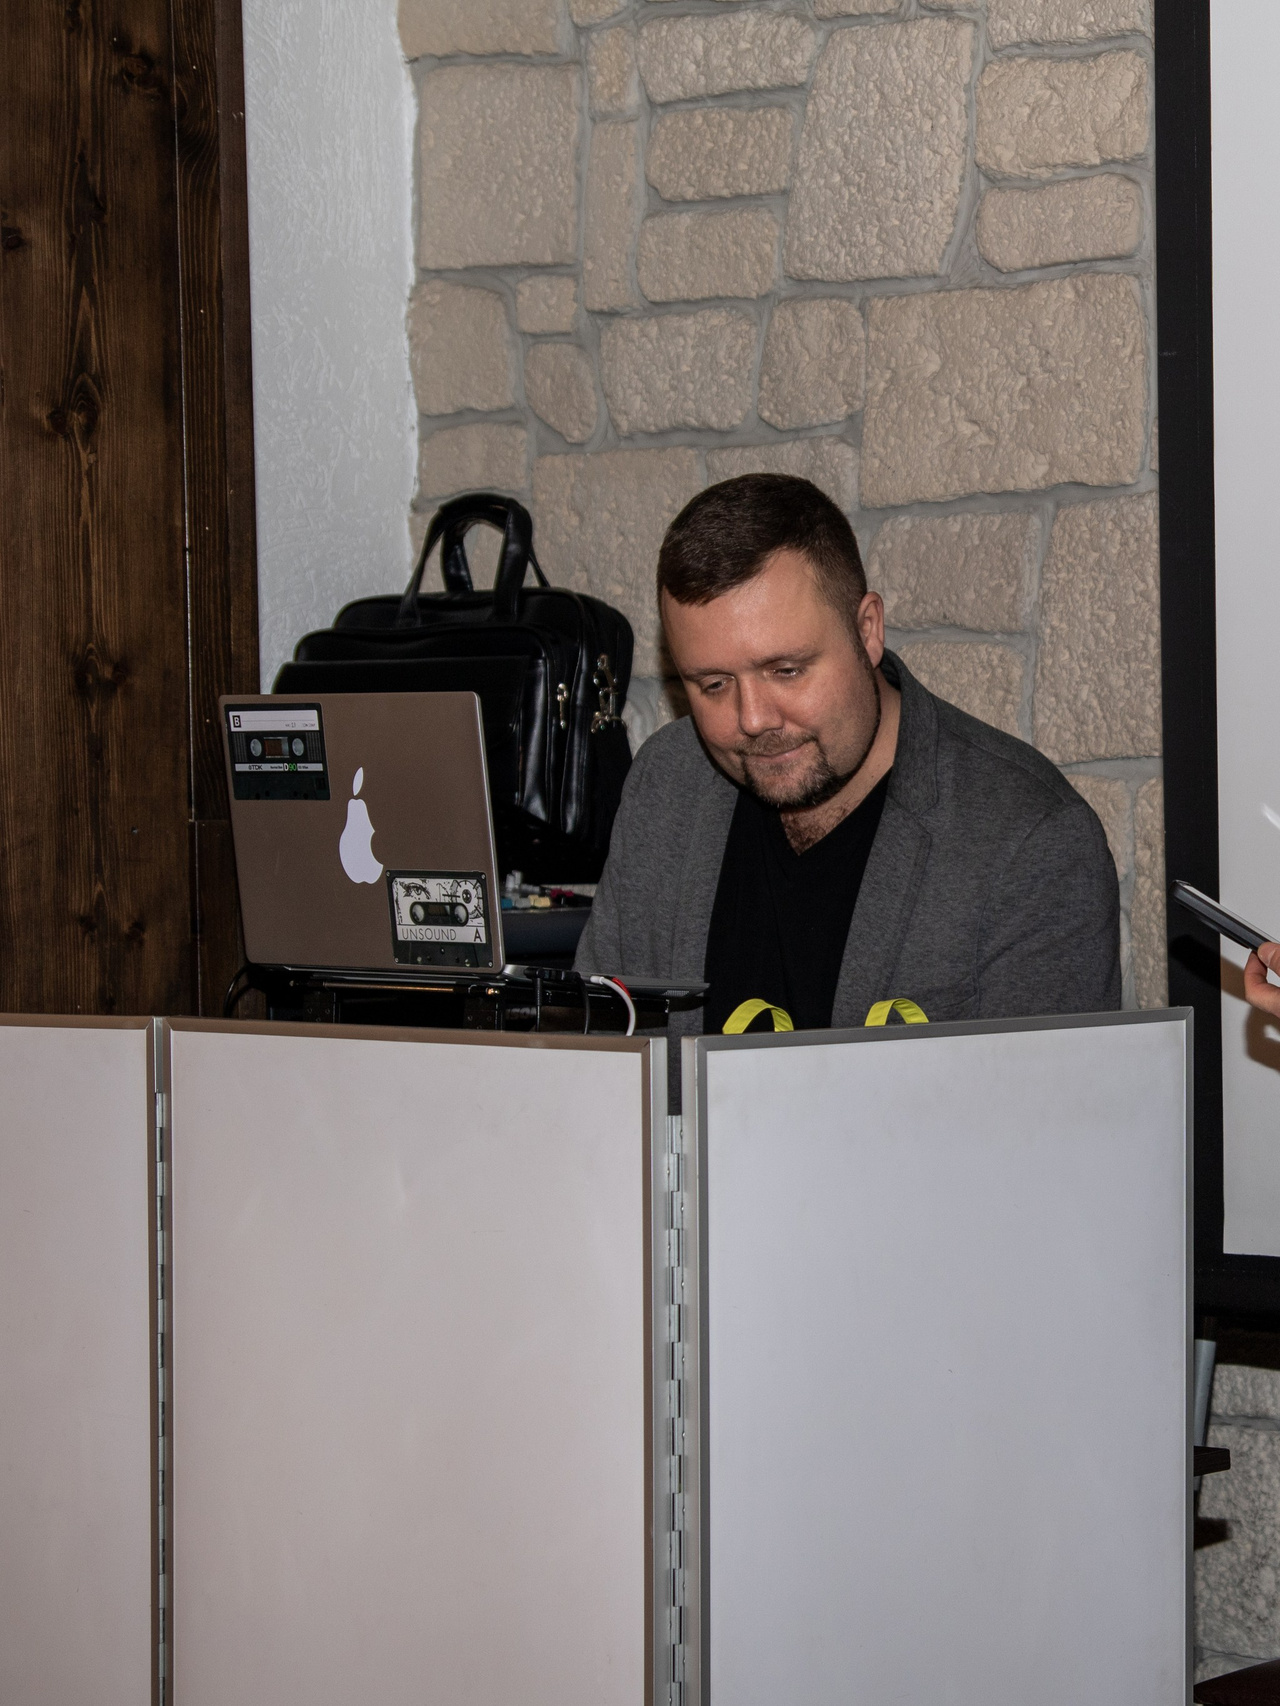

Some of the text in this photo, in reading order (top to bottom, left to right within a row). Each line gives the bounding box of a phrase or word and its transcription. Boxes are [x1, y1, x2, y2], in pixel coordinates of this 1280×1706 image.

[233, 716, 240, 727] B
[401, 928, 483, 943] UNSOUND A
